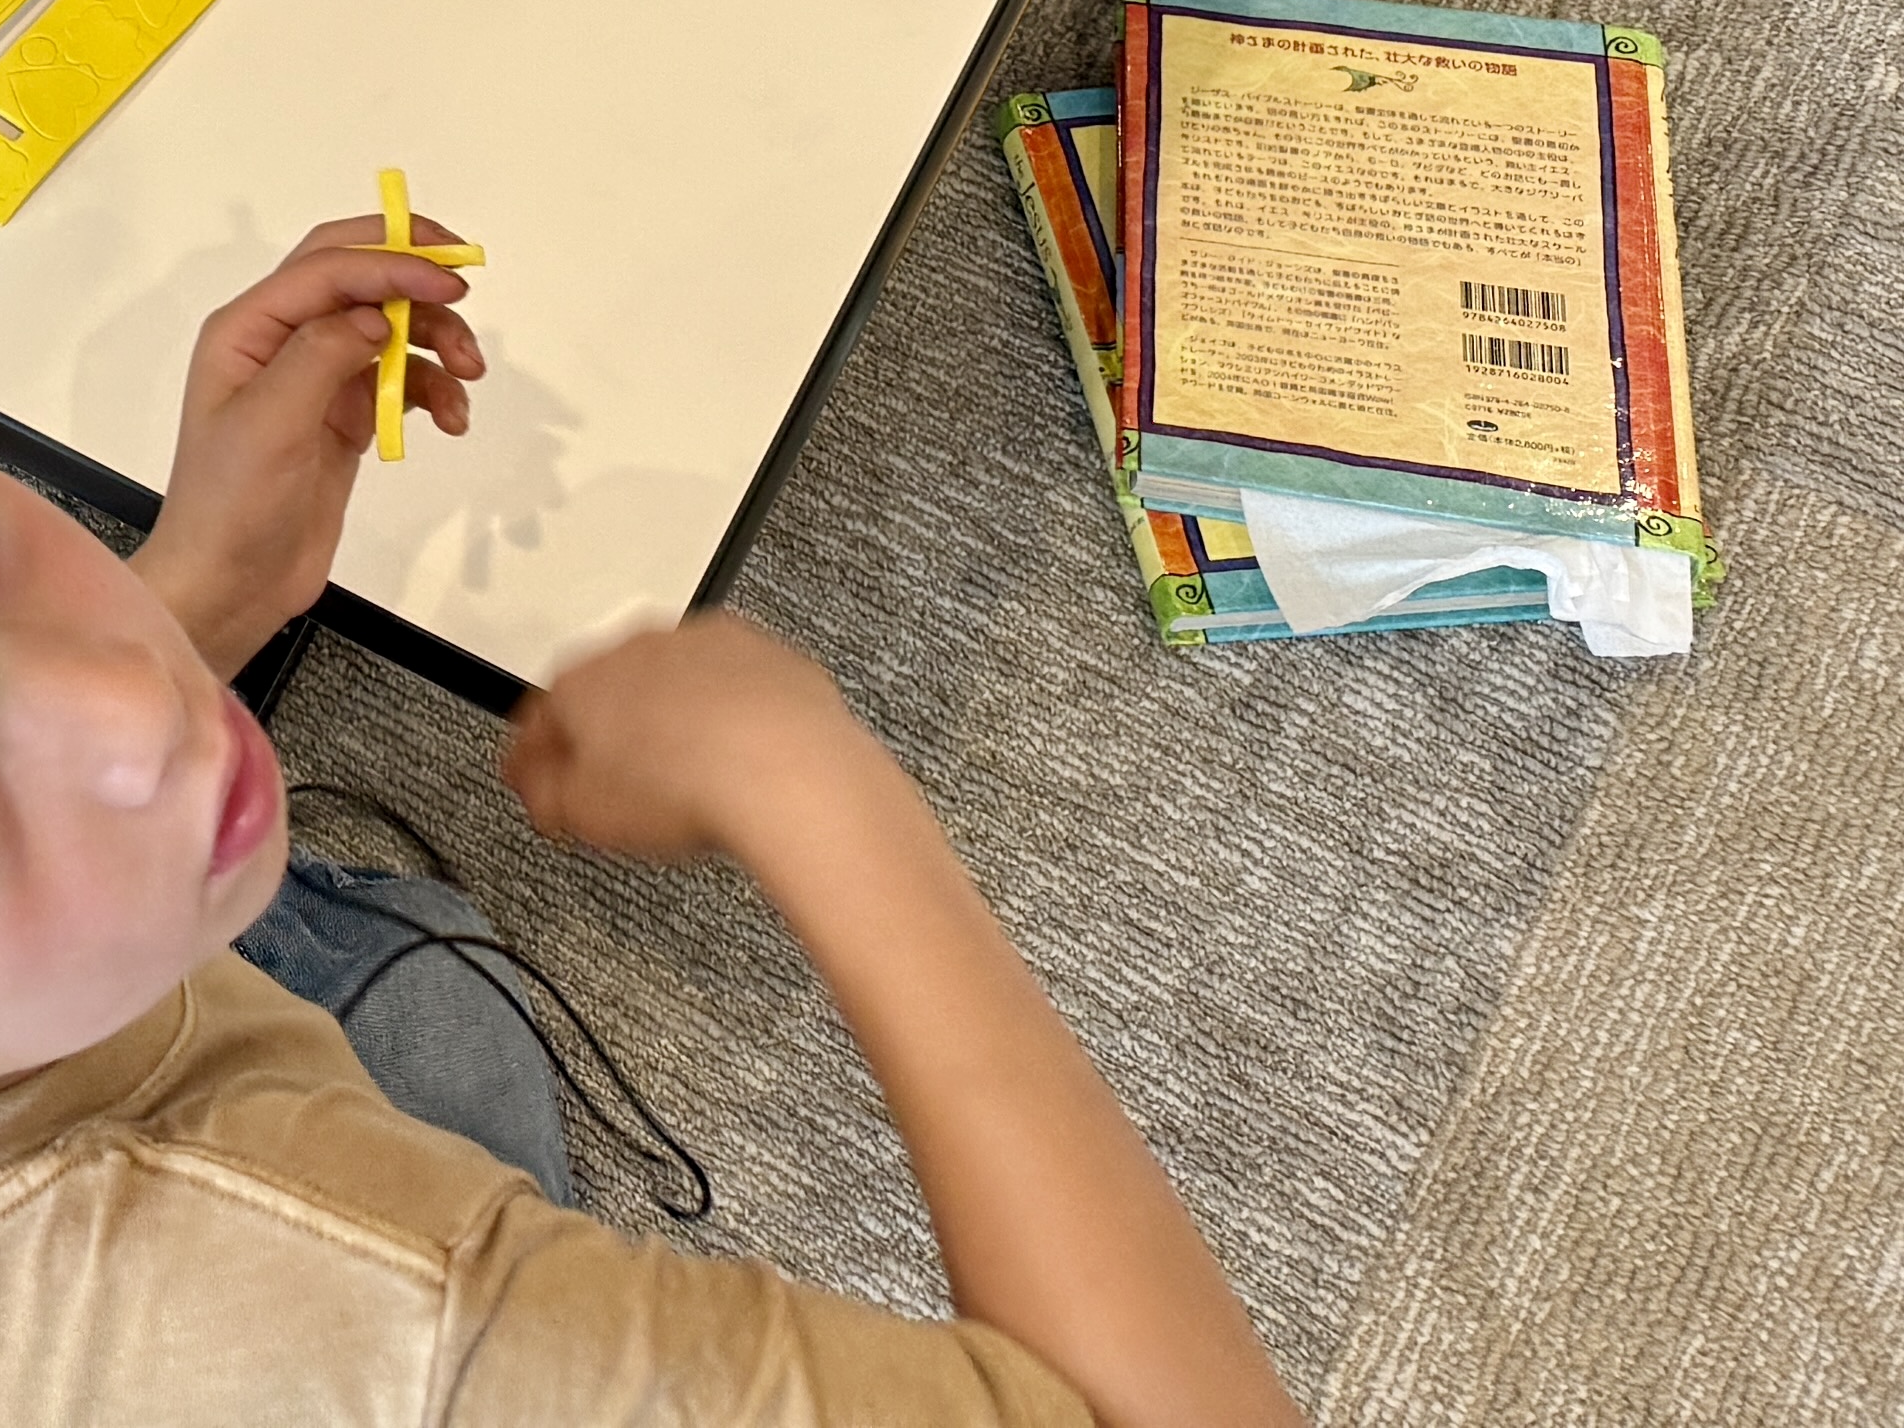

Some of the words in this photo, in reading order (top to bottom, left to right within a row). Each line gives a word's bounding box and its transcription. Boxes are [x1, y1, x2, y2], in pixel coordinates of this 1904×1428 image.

[1230, 32, 1517, 77] 神さまの計画された、壮大な救いの物語
[1461, 310, 1567, 333] 9784264027508
[1465, 363, 1570, 387] 1928716028004
